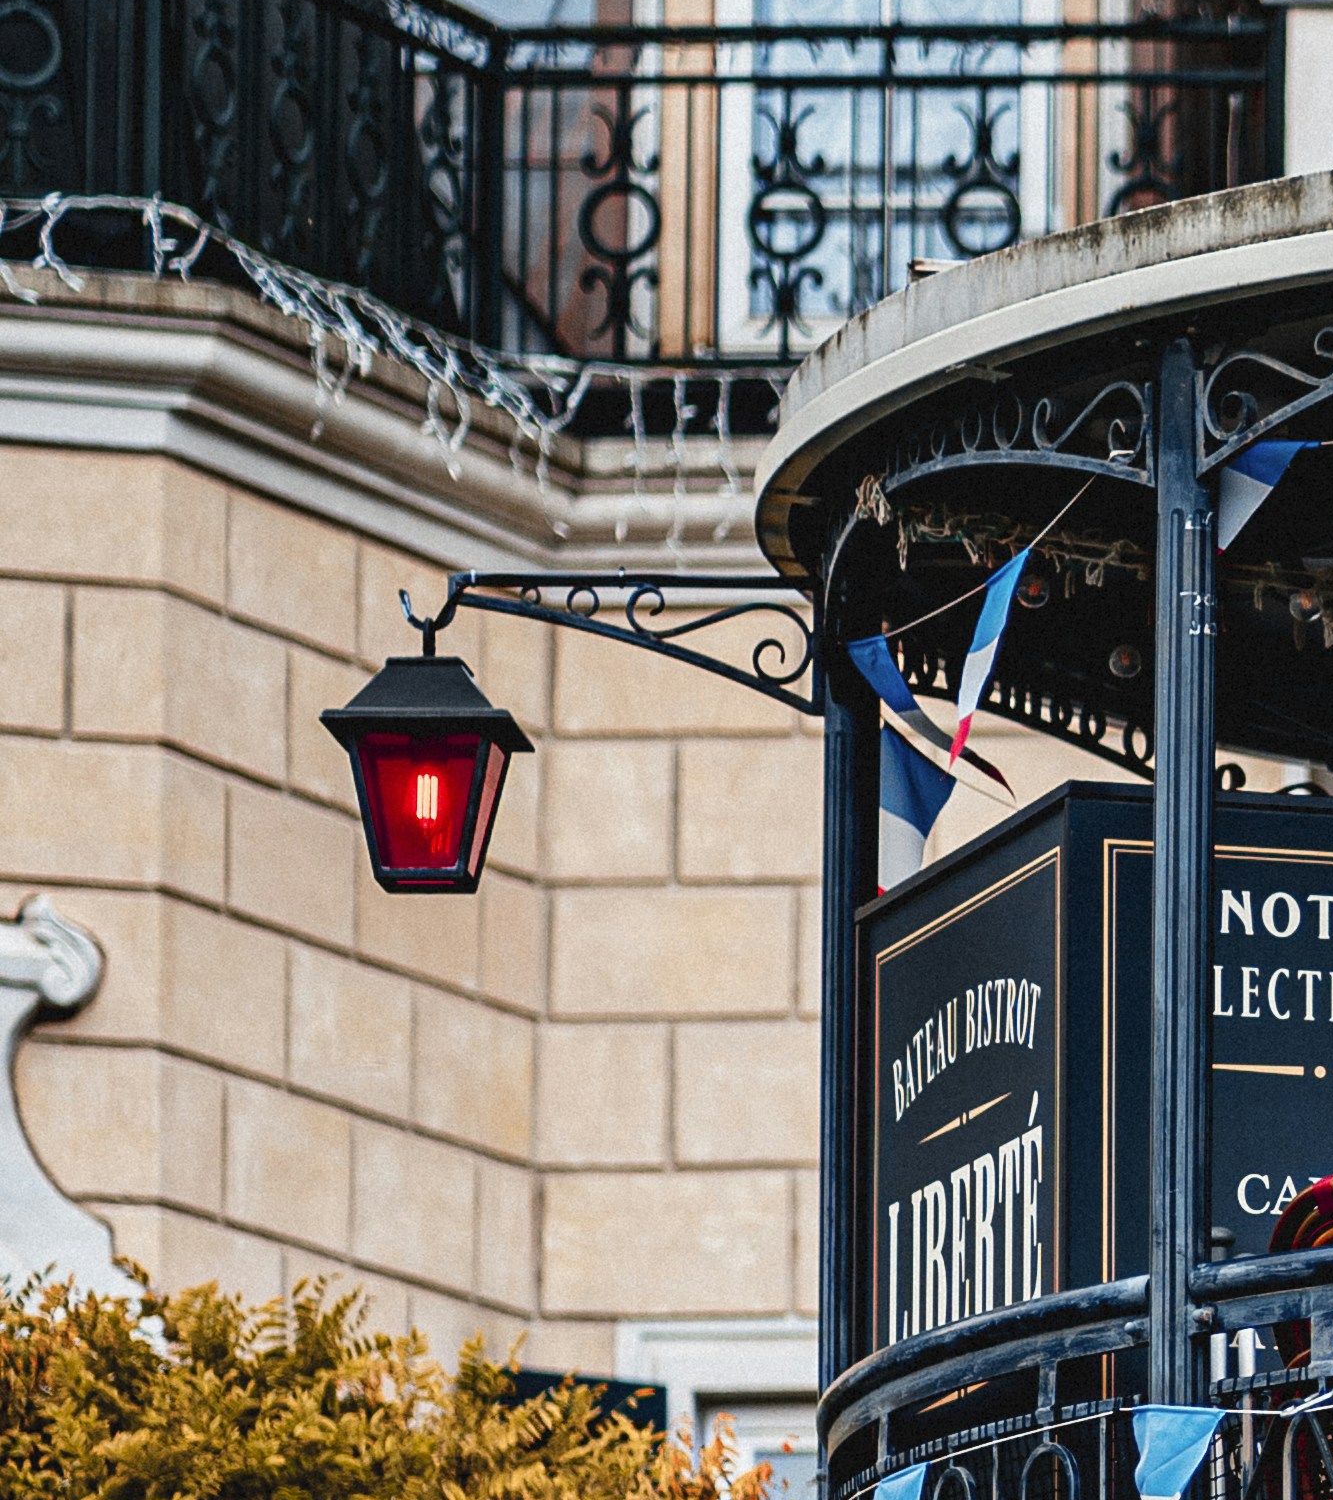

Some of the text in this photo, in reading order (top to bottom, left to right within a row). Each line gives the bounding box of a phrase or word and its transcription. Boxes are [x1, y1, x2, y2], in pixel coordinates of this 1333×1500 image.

[891, 977, 1042, 1123] BATEAU BISTROT
[887, 1090, 1044, 1347] LIBERTÉ
